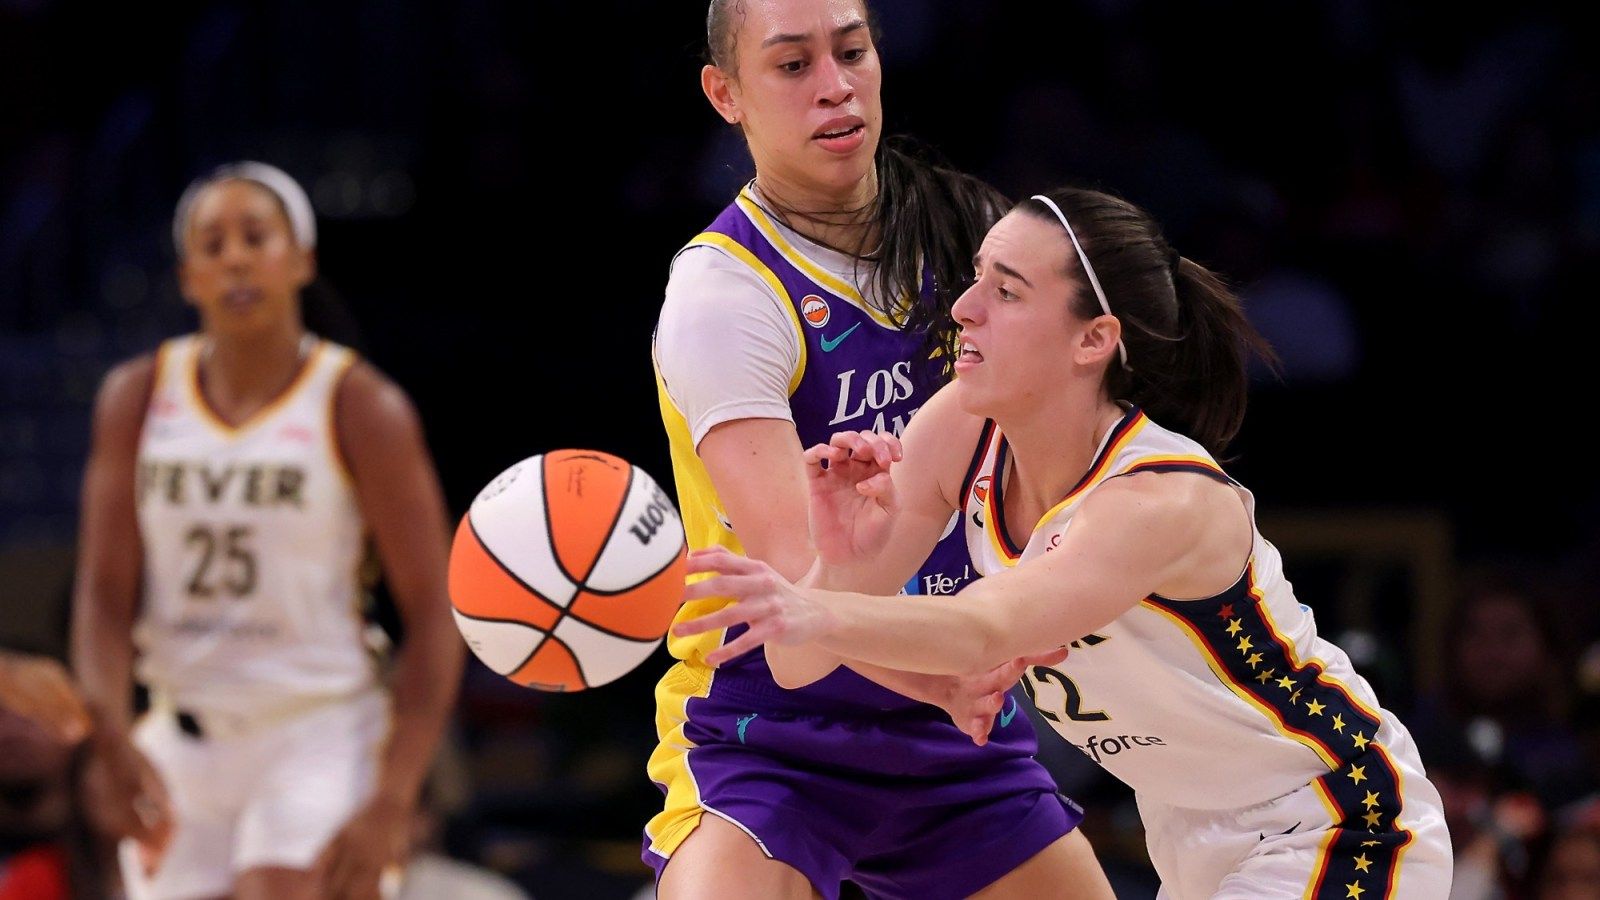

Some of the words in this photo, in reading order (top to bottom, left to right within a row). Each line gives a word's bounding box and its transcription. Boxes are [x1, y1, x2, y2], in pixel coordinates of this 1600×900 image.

[829, 361, 914, 426] LOS
[140, 460, 306, 510] FEVER
[185, 522, 258, 600] 25
